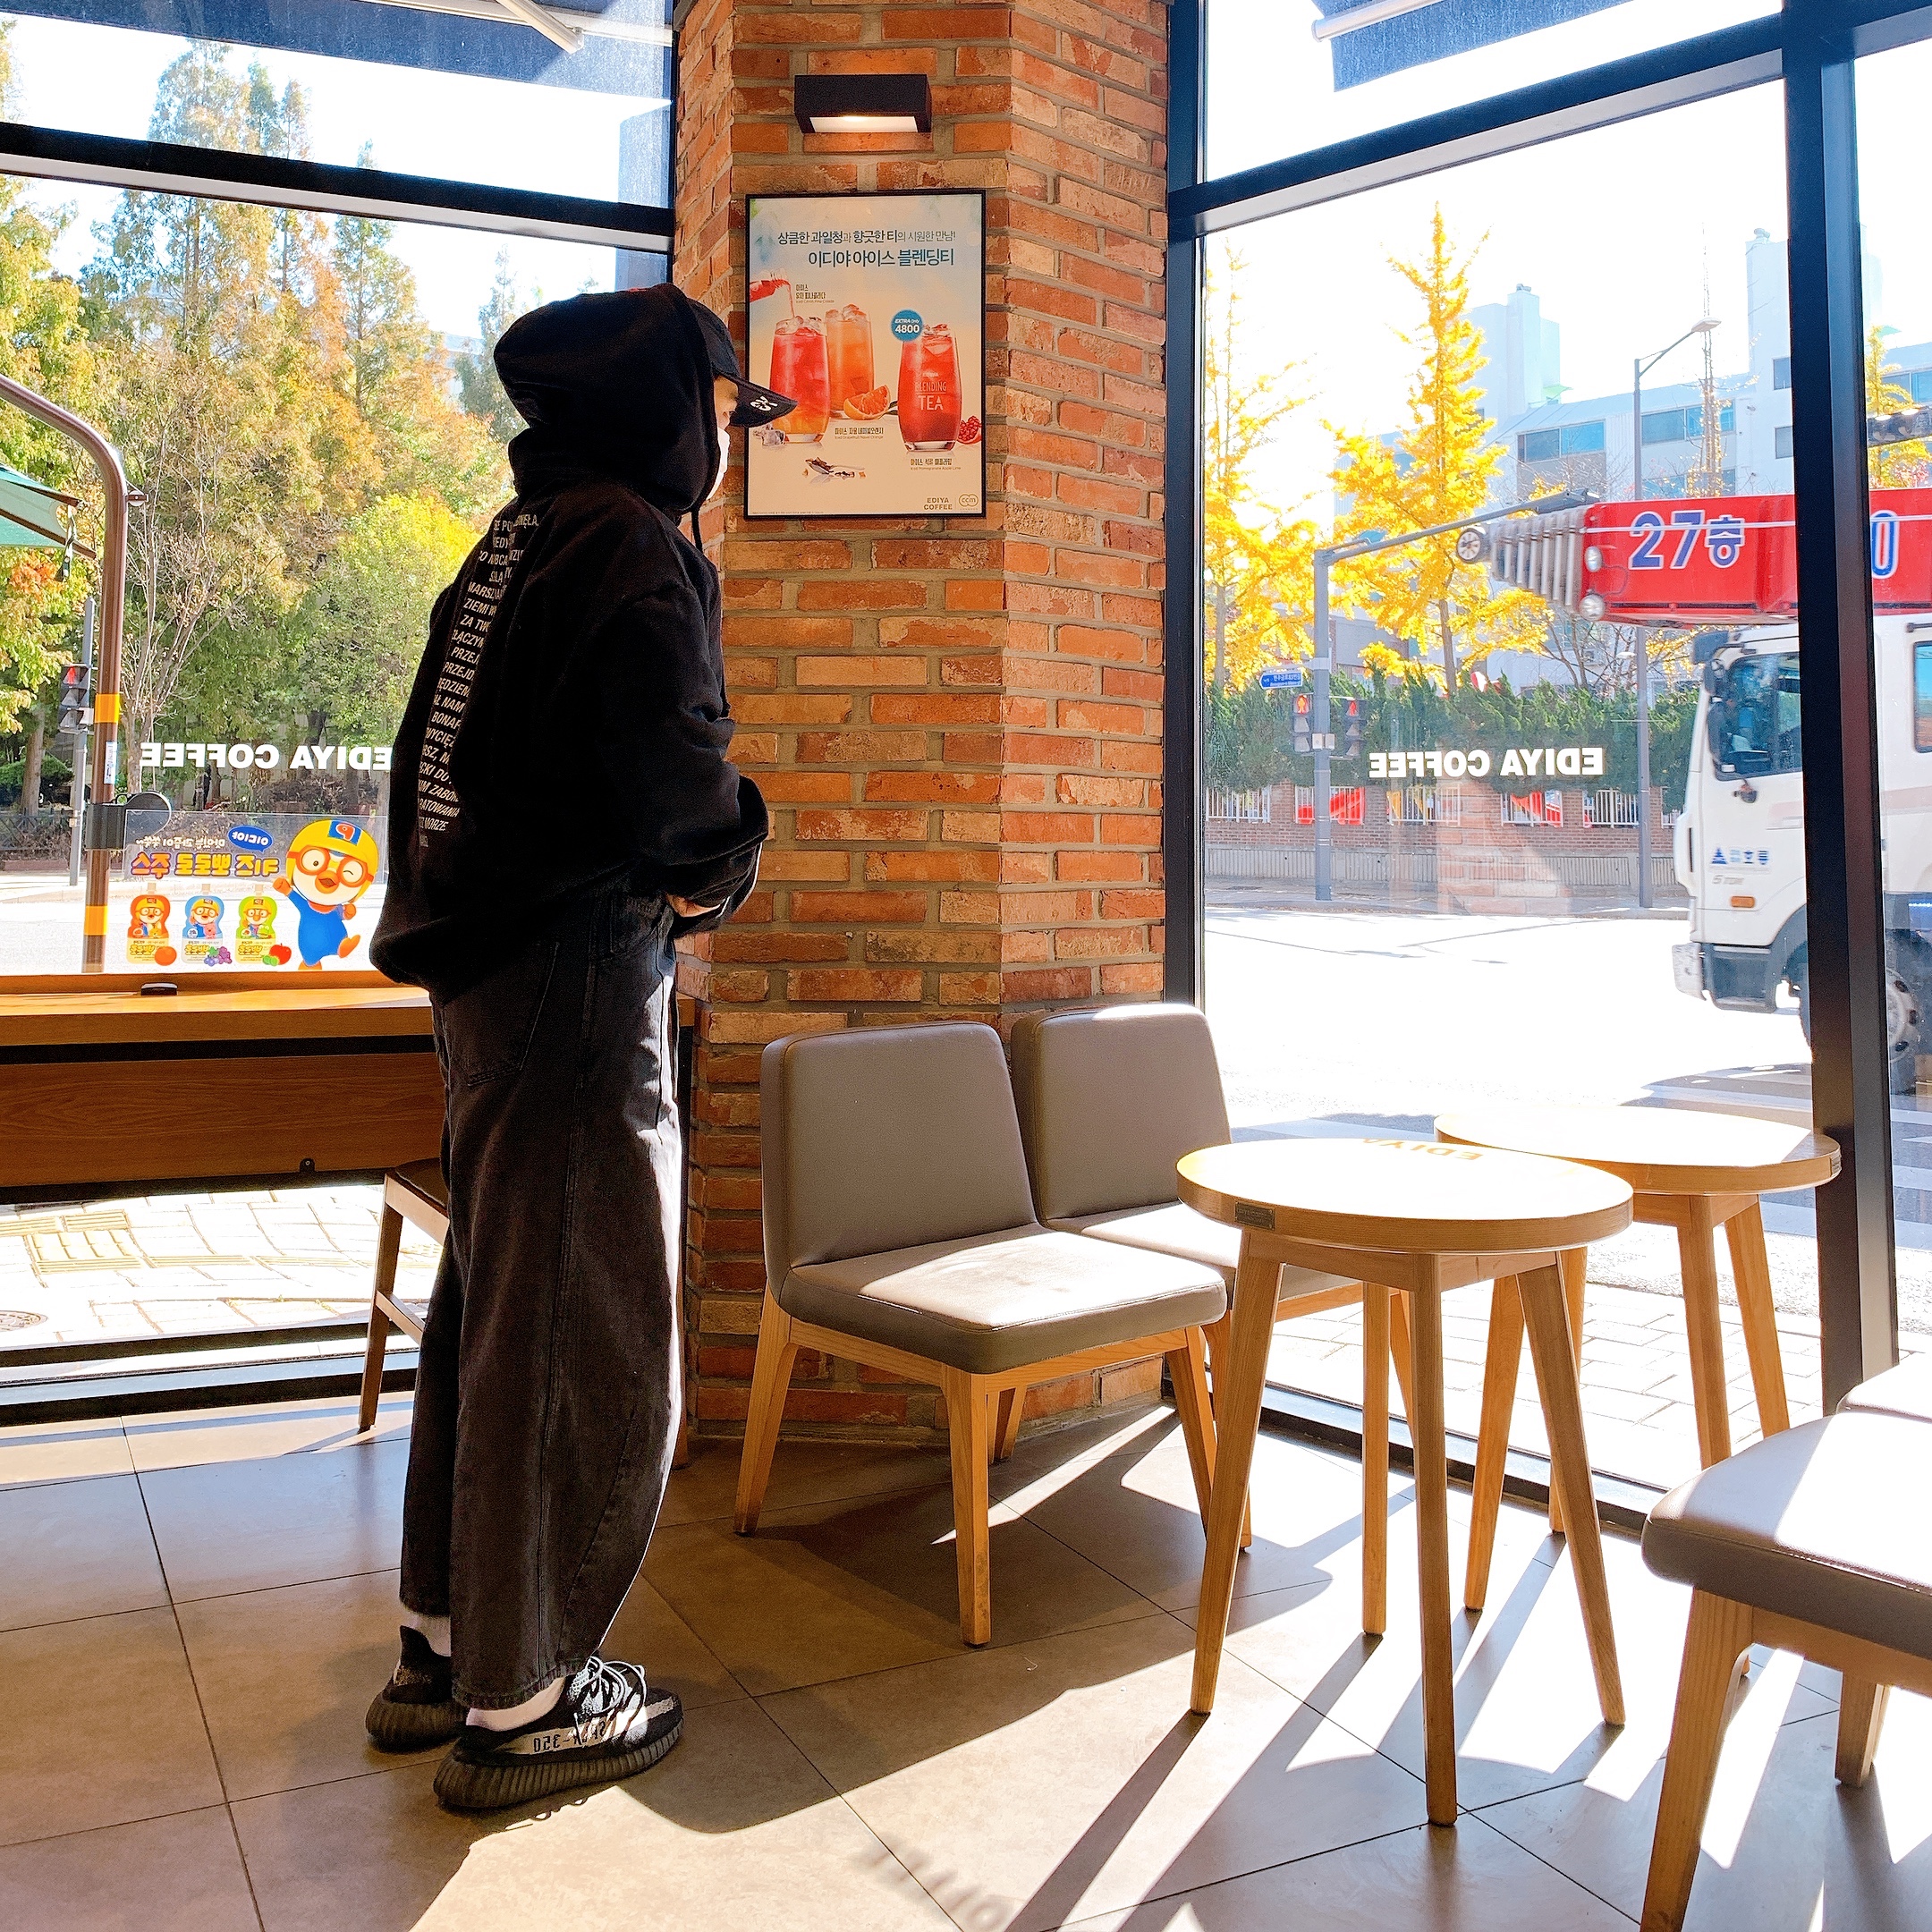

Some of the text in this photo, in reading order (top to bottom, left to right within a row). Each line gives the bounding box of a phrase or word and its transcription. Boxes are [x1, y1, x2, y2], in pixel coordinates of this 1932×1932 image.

[777, 230, 956, 245] 상큼한 과일청과 향긋한 티의 시원한 만남!
[809, 248, 954, 268] 이디야 아이스 블렌딩티
[894, 324, 920, 334] 4800
[914, 381, 947, 392] BLENDING
[918, 395, 944, 411] TEA
[1628, 509, 1745, 570] 27층
[460, 614, 474, 627] ZA
[441, 697, 466, 713] NAM
